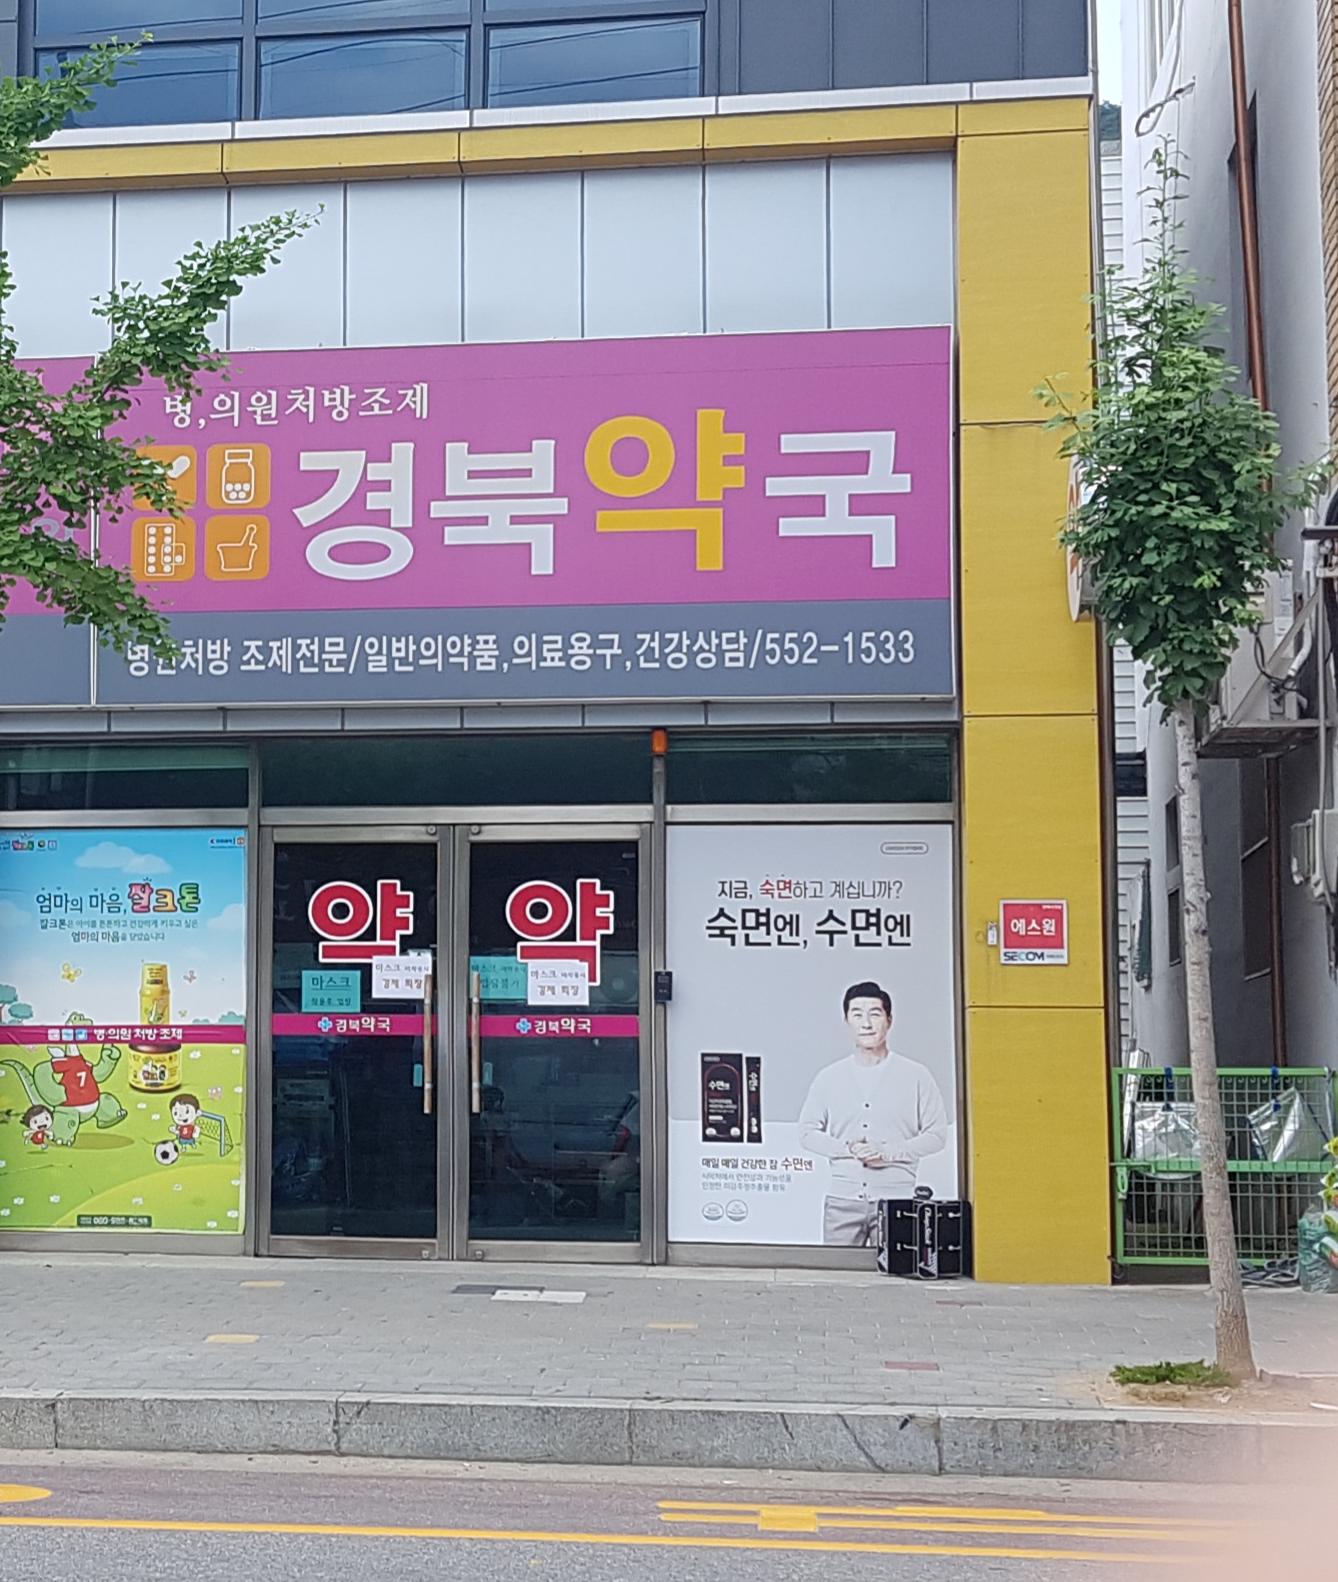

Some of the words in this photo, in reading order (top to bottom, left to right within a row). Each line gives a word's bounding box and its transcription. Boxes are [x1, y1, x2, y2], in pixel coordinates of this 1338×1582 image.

[292, 408, 912, 580] 경북약국
[717, 880, 753, 900] 지금,
[759, 878, 824, 899] 숙면하고
[829, 880, 903, 899] 계십니까?
[36, 893, 83, 914] 엄마의
[307, 879, 414, 963] 약
[705, 907, 808, 949] 숙면엔,
[815, 907, 913, 948] 수면엔
[1010, 918, 1056, 936] 에스원
[71, 931, 99, 943] 엄마의
[505, 878, 615, 986] 약
[1003, 951, 1045, 961] SECOM
[375, 963, 401, 973] 마스크
[530, 970, 557, 979] 마스크
[311, 975, 351, 990] 마스크
[335, 1016, 391, 1033] 경북약국
[534, 1017, 592, 1034] 경북약국
[133, 1028, 158, 1040] 처방
[159, 1028, 183, 1040] 조제
[76, 1071, 87, 1087] 7
[701, 1158, 720, 1169] 매일
[721, 1158, 739, 1169] 매일
[741, 1158, 767, 1170] 건강한
[781, 1157, 813, 1171] 수면엔
